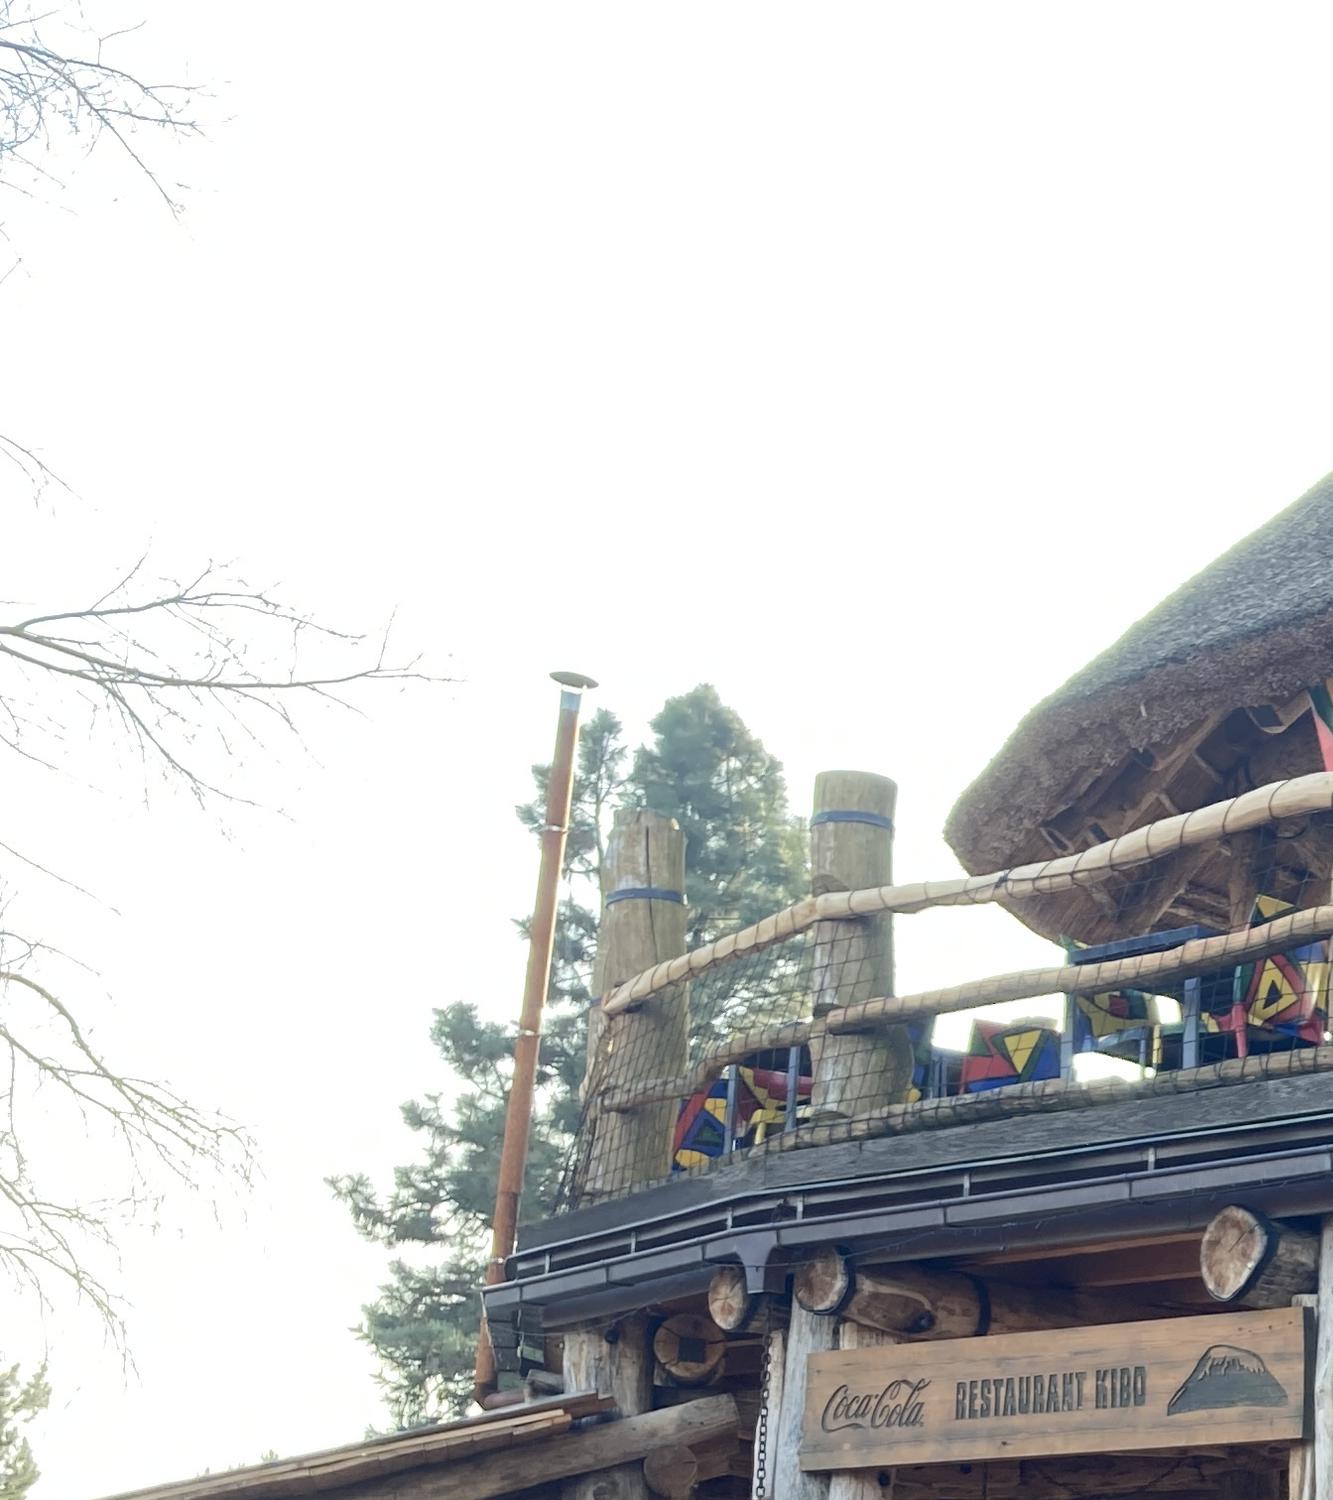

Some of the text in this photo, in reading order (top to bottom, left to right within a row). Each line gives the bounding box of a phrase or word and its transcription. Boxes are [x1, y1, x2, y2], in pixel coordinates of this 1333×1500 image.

[822, 1378, 931, 1434] Coca-Cola
[955, 1365, 1146, 1420] RESTAURANT KIBO
